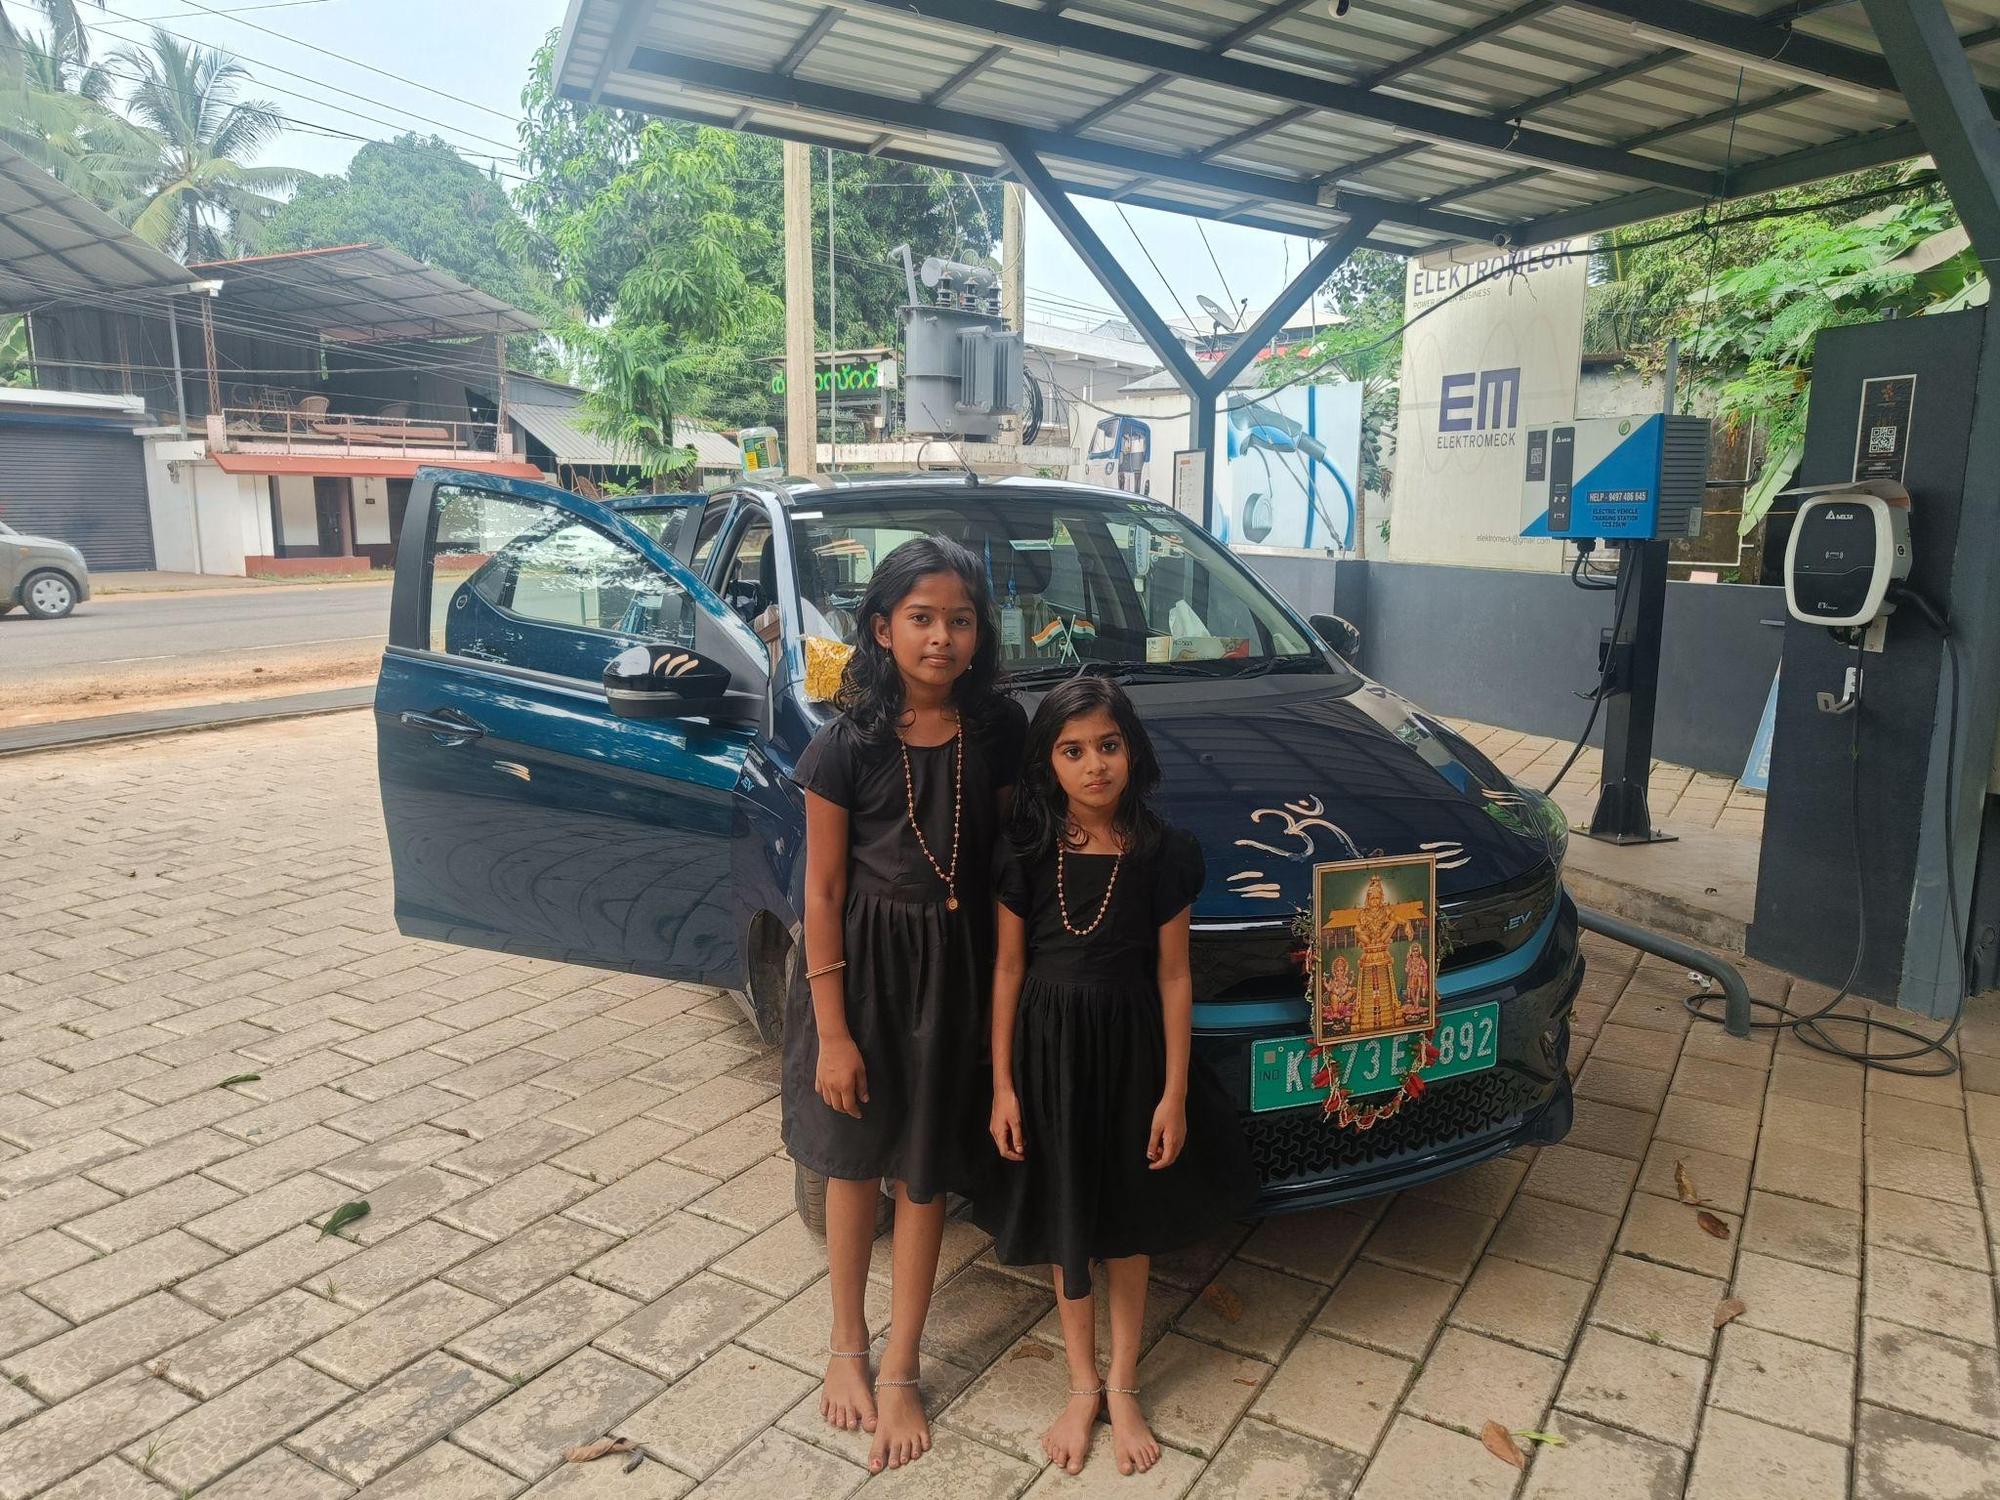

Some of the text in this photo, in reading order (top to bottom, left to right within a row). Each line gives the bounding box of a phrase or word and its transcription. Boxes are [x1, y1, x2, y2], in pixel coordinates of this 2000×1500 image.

[1413, 240, 1573, 296] ELEKTROMECK
[1459, 288, 1491, 302] BUSINESS
[1439, 367, 1521, 432] EM
[1437, 432, 1516, 449] ELEKTROMECK
[1589, 492, 1604, 502] HELP
[1341, 1040, 1381, 1085] 73
[1422, 1017, 1493, 1067] 892
